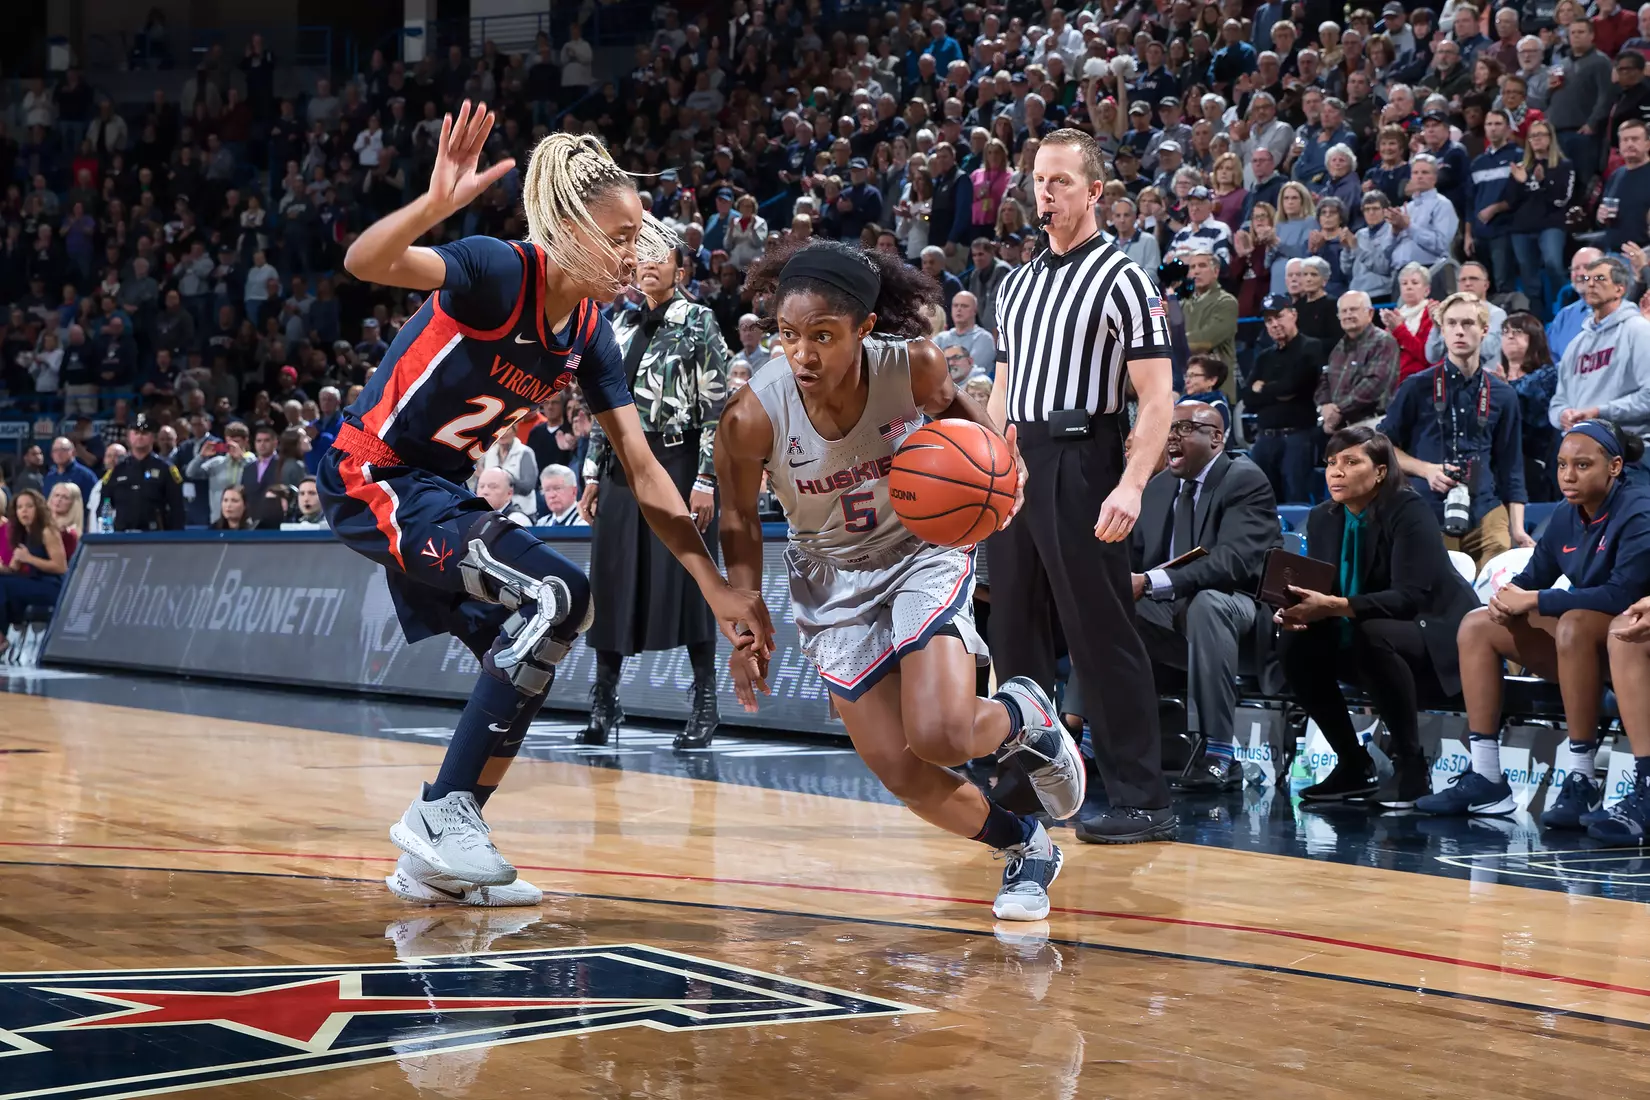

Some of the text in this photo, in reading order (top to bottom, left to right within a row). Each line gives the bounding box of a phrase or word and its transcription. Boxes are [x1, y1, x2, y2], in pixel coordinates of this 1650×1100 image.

[795, 455, 892, 494] HUSKIE
[841, 491, 878, 533] 5
[208, 569, 346, 636] BRUNETTI
